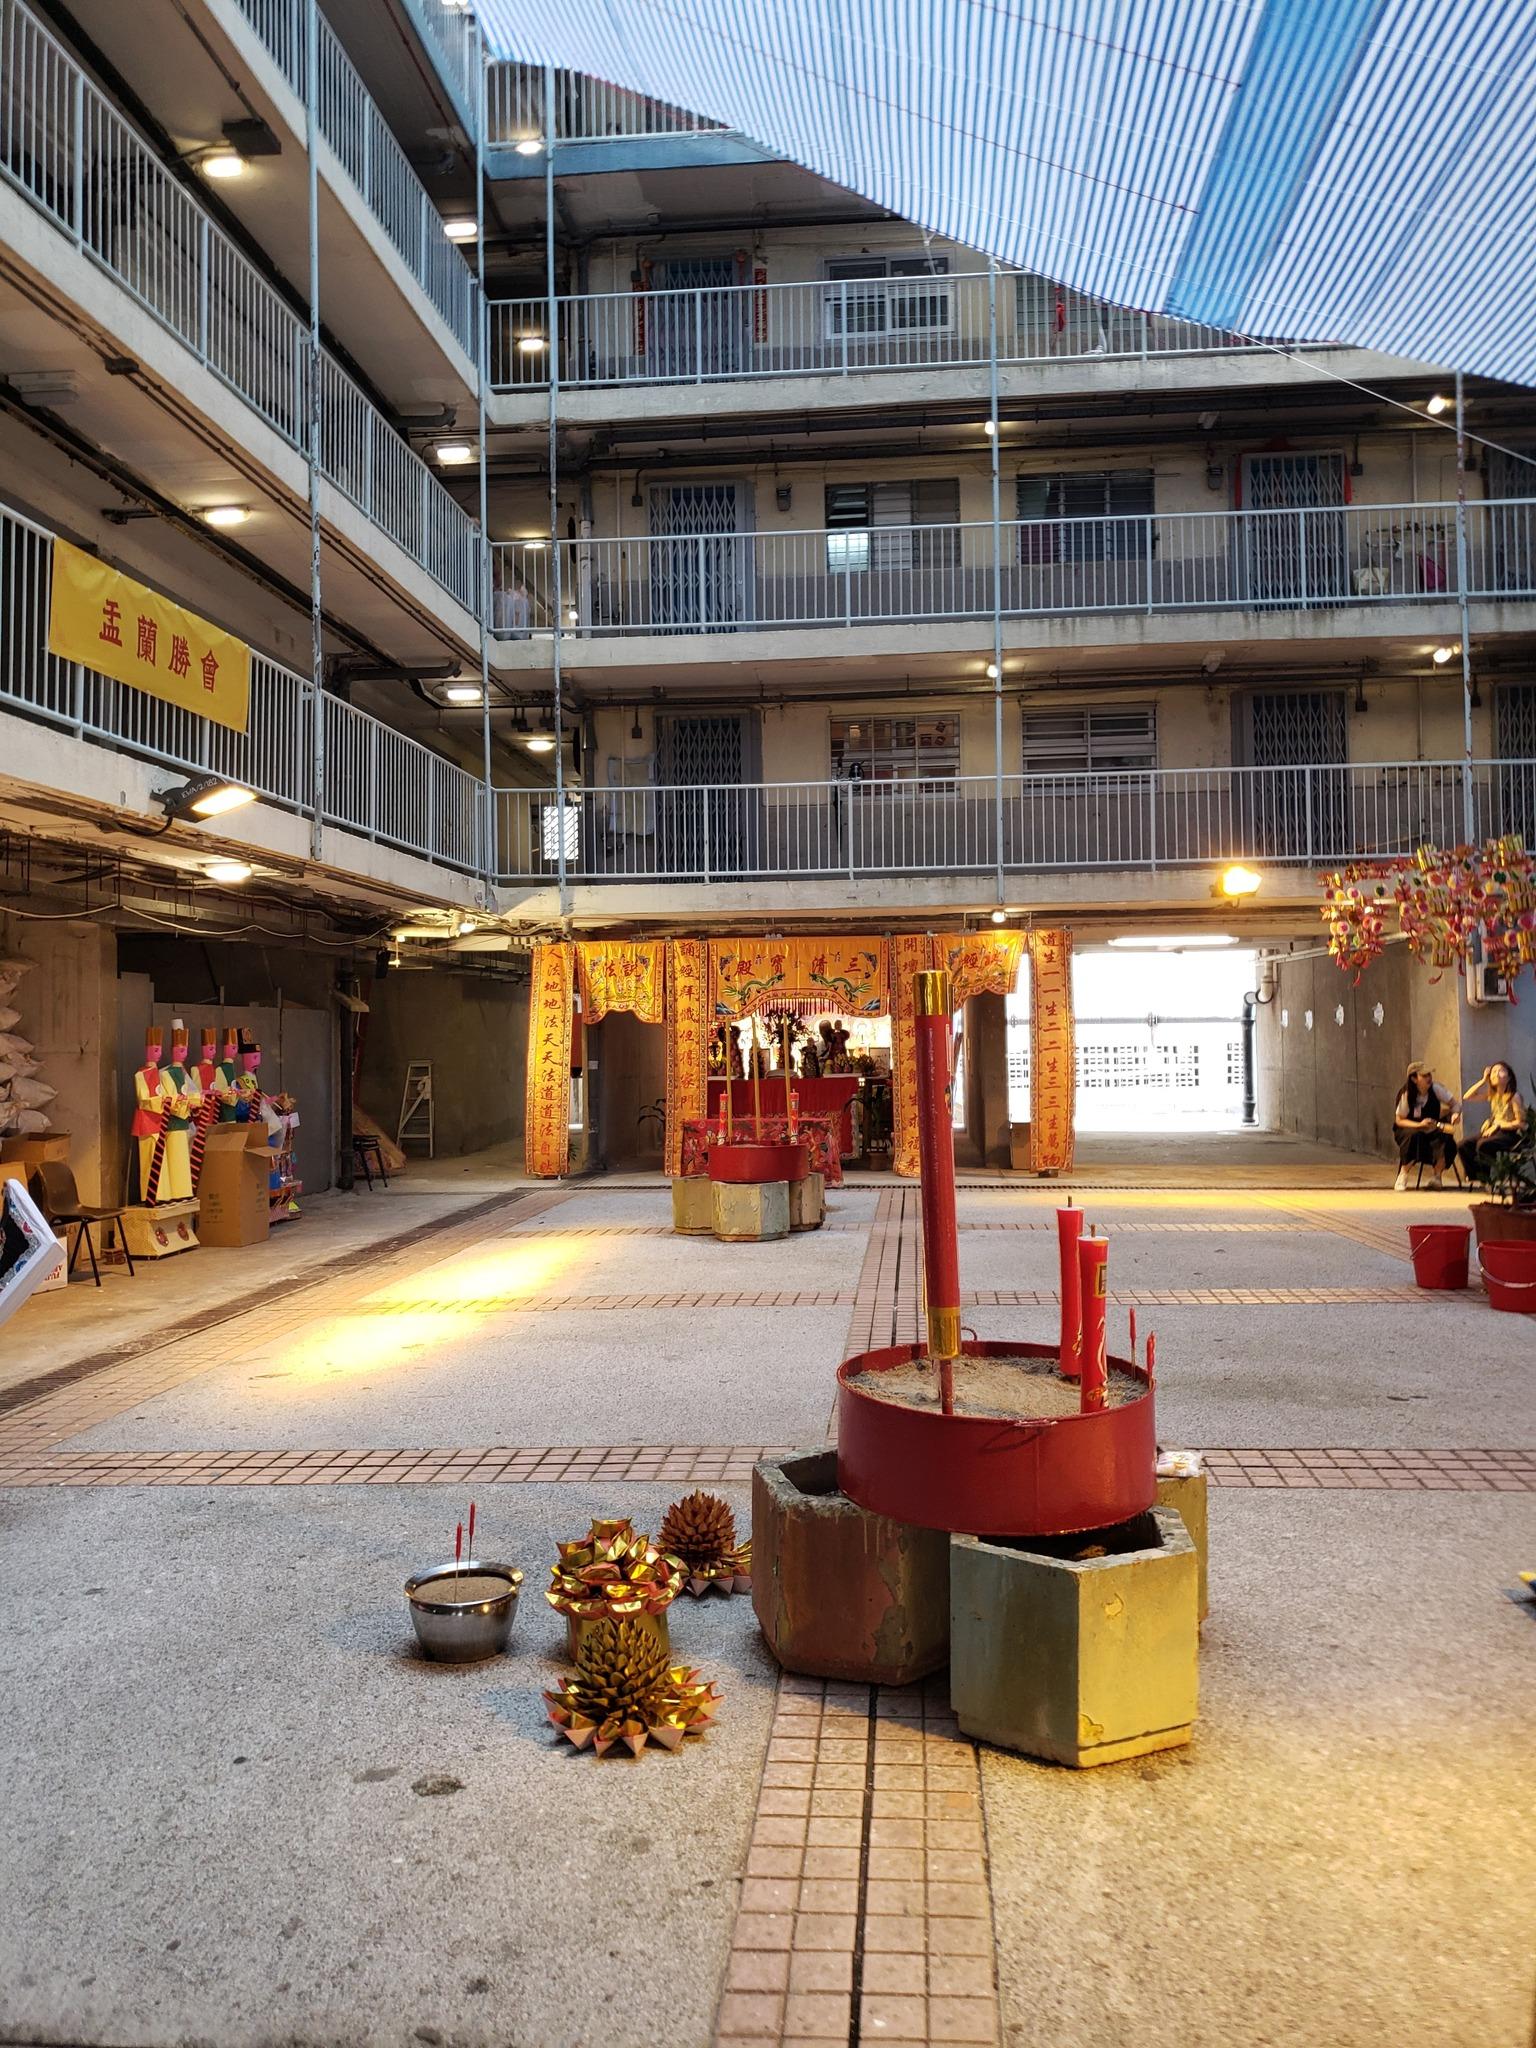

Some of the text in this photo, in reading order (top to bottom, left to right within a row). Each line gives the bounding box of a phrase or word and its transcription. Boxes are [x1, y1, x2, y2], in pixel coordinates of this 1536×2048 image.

[98, 598, 220, 693] 盂蘭勝會
[679, 942, 695, 1123] 誦經拜懺但得家門
[1040, 932, 1061, 1167] 道生一一生二二生三三生萬物
